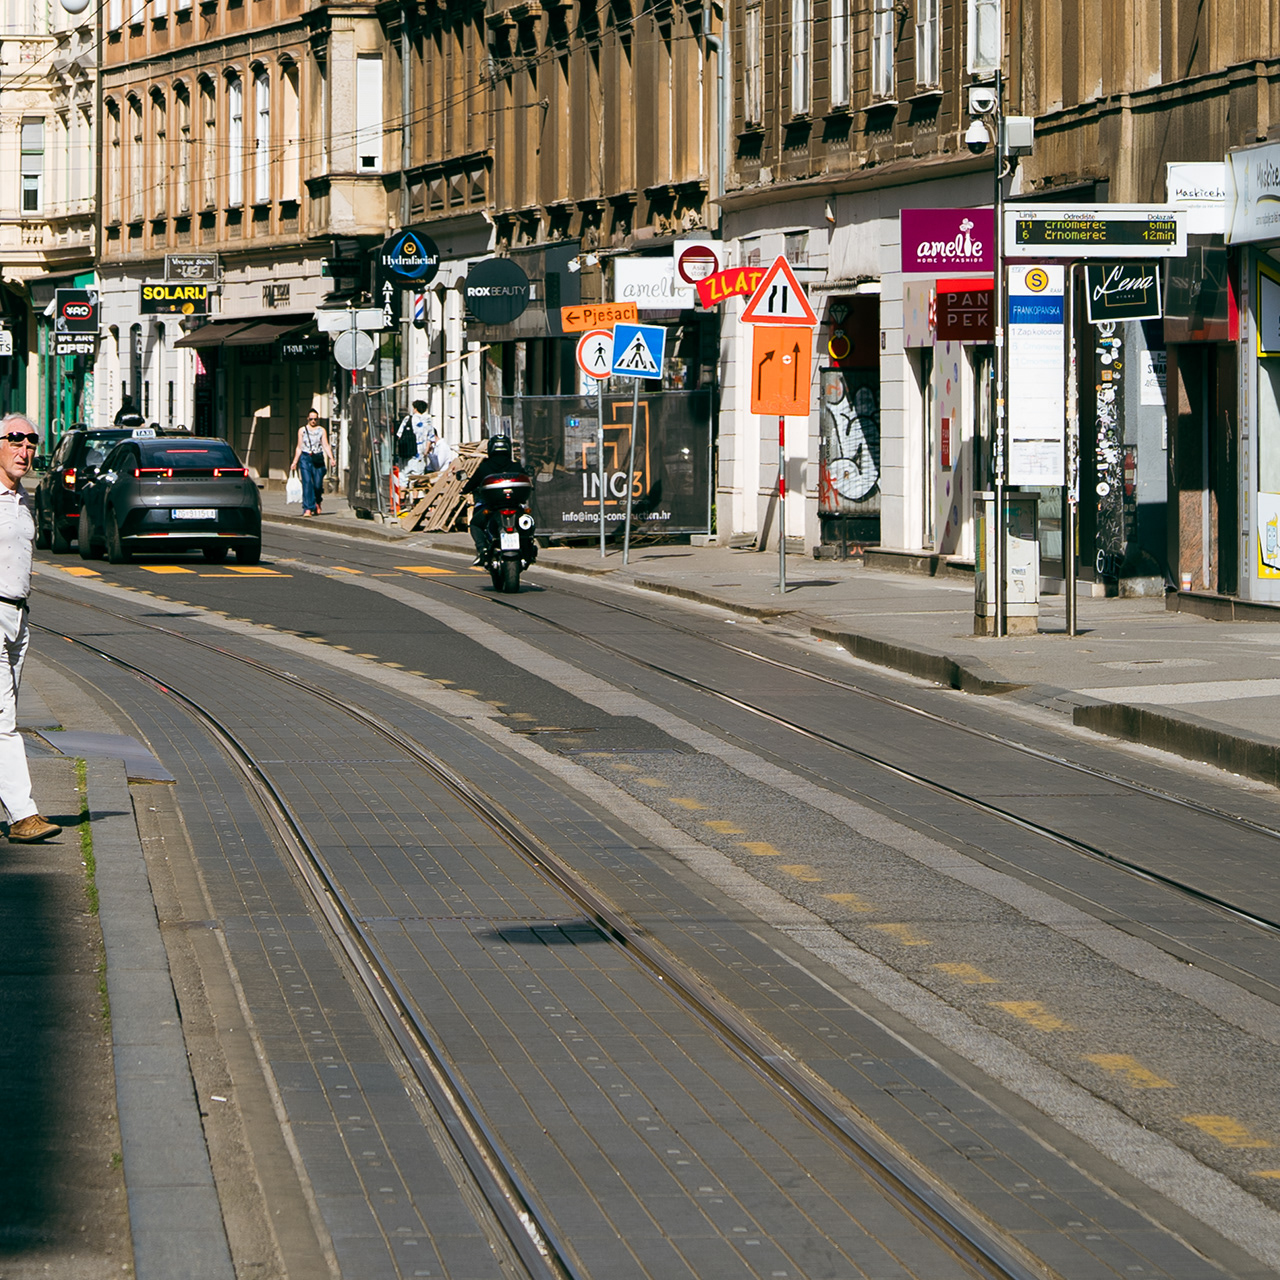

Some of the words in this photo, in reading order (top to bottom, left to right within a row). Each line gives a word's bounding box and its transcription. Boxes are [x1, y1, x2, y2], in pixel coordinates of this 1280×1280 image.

[1022, 231, 1030, 240] 6
[1142, 231, 1175, 240] 12min
[916, 233, 983, 257] amelie
[705, 271, 762, 300] ZLAT
[1031, 273, 1043, 287] S
[143, 286, 207, 301] SOLARIJ
[467, 286, 491, 297] ROX
[491, 285, 526, 296] BEAUTY
[947, 293, 989, 306] PAN
[583, 307, 636, 326] Pješaci
[1013, 305, 1061, 315] FRANKOPANSKA
[947, 313, 989, 327] PEK
[57, 343, 95, 354] OPEN
[582, 471, 644, 499] ING3
[562, 510, 672, 523] info@ing-consruction.hr
